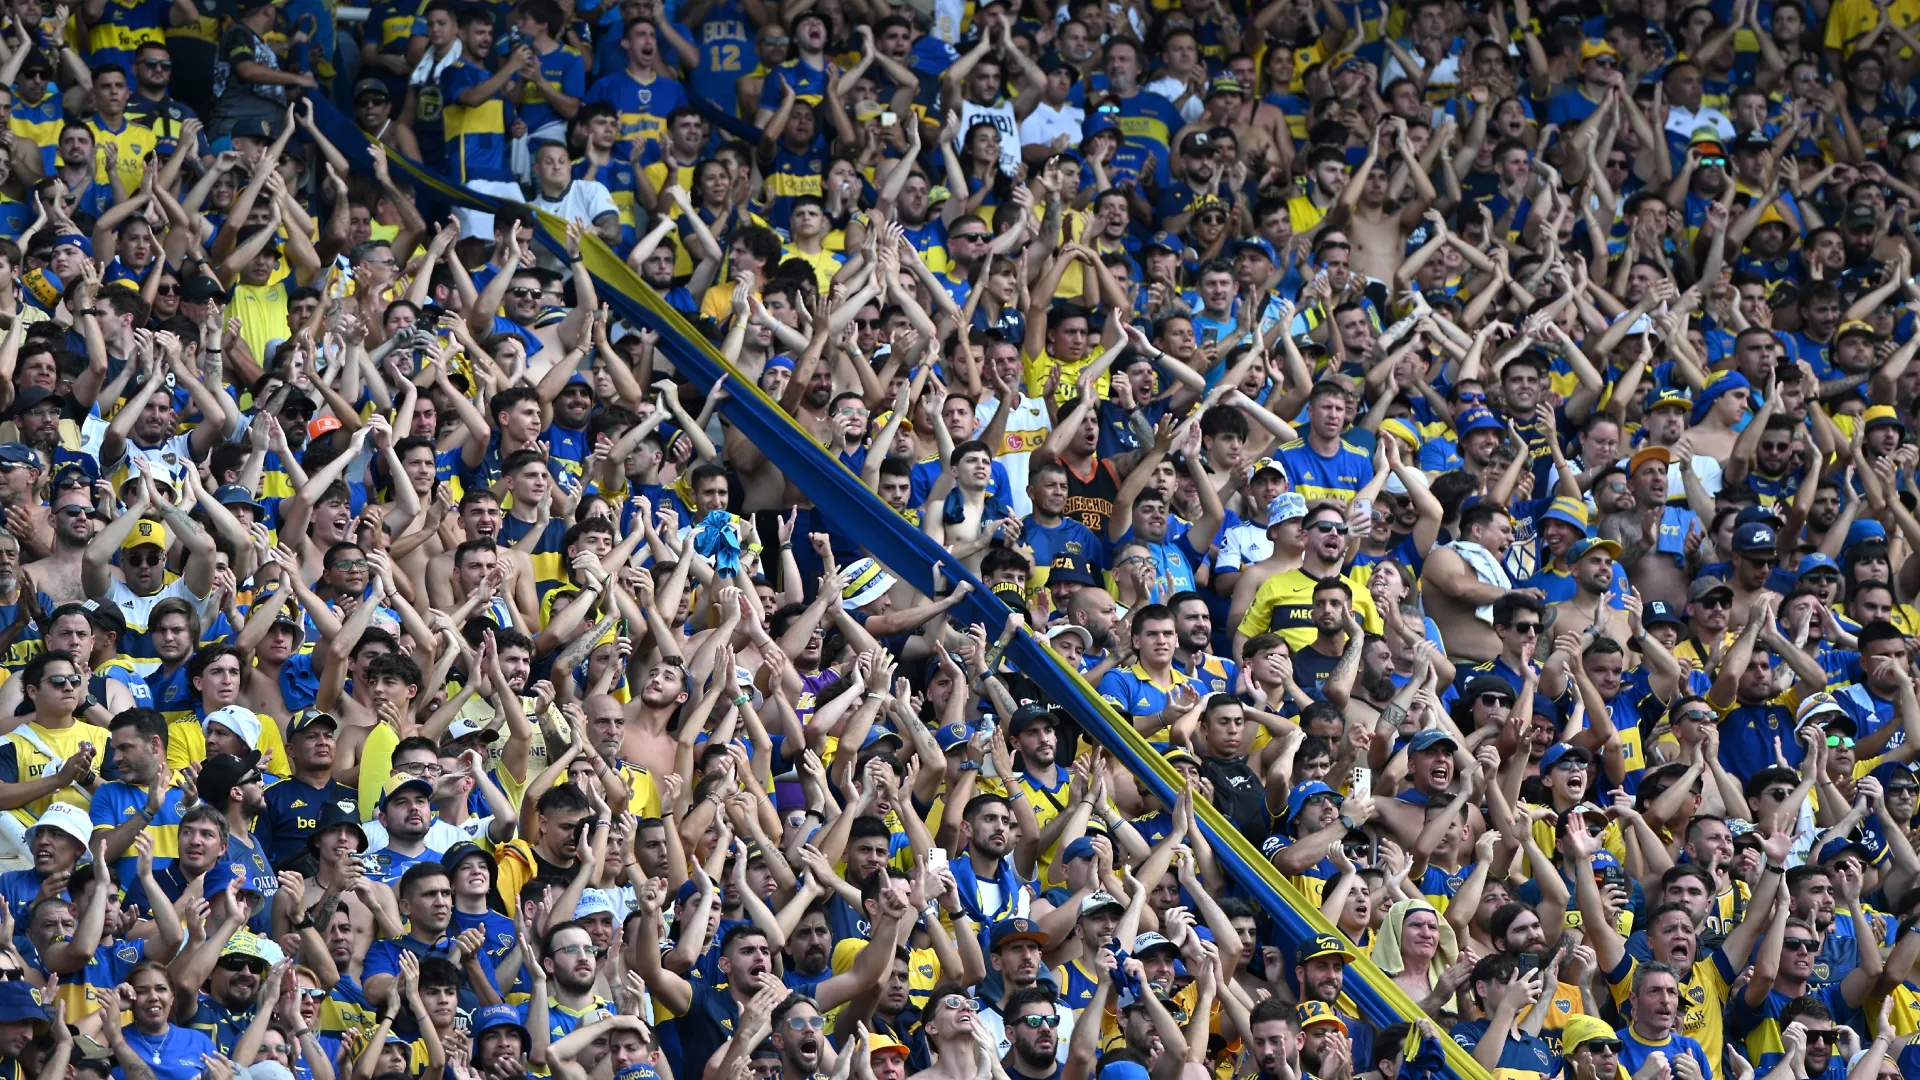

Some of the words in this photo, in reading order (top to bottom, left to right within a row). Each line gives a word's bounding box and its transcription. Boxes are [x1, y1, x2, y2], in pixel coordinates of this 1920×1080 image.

[702, 20, 747, 44] BOCA
[711, 45, 742, 71] 12
[1025, 434, 1044, 447] LG
[1083, 512, 1102, 531] 32
[1321, 941, 1339, 950] CABJ
[1298, 1001, 1325, 1020] 12
